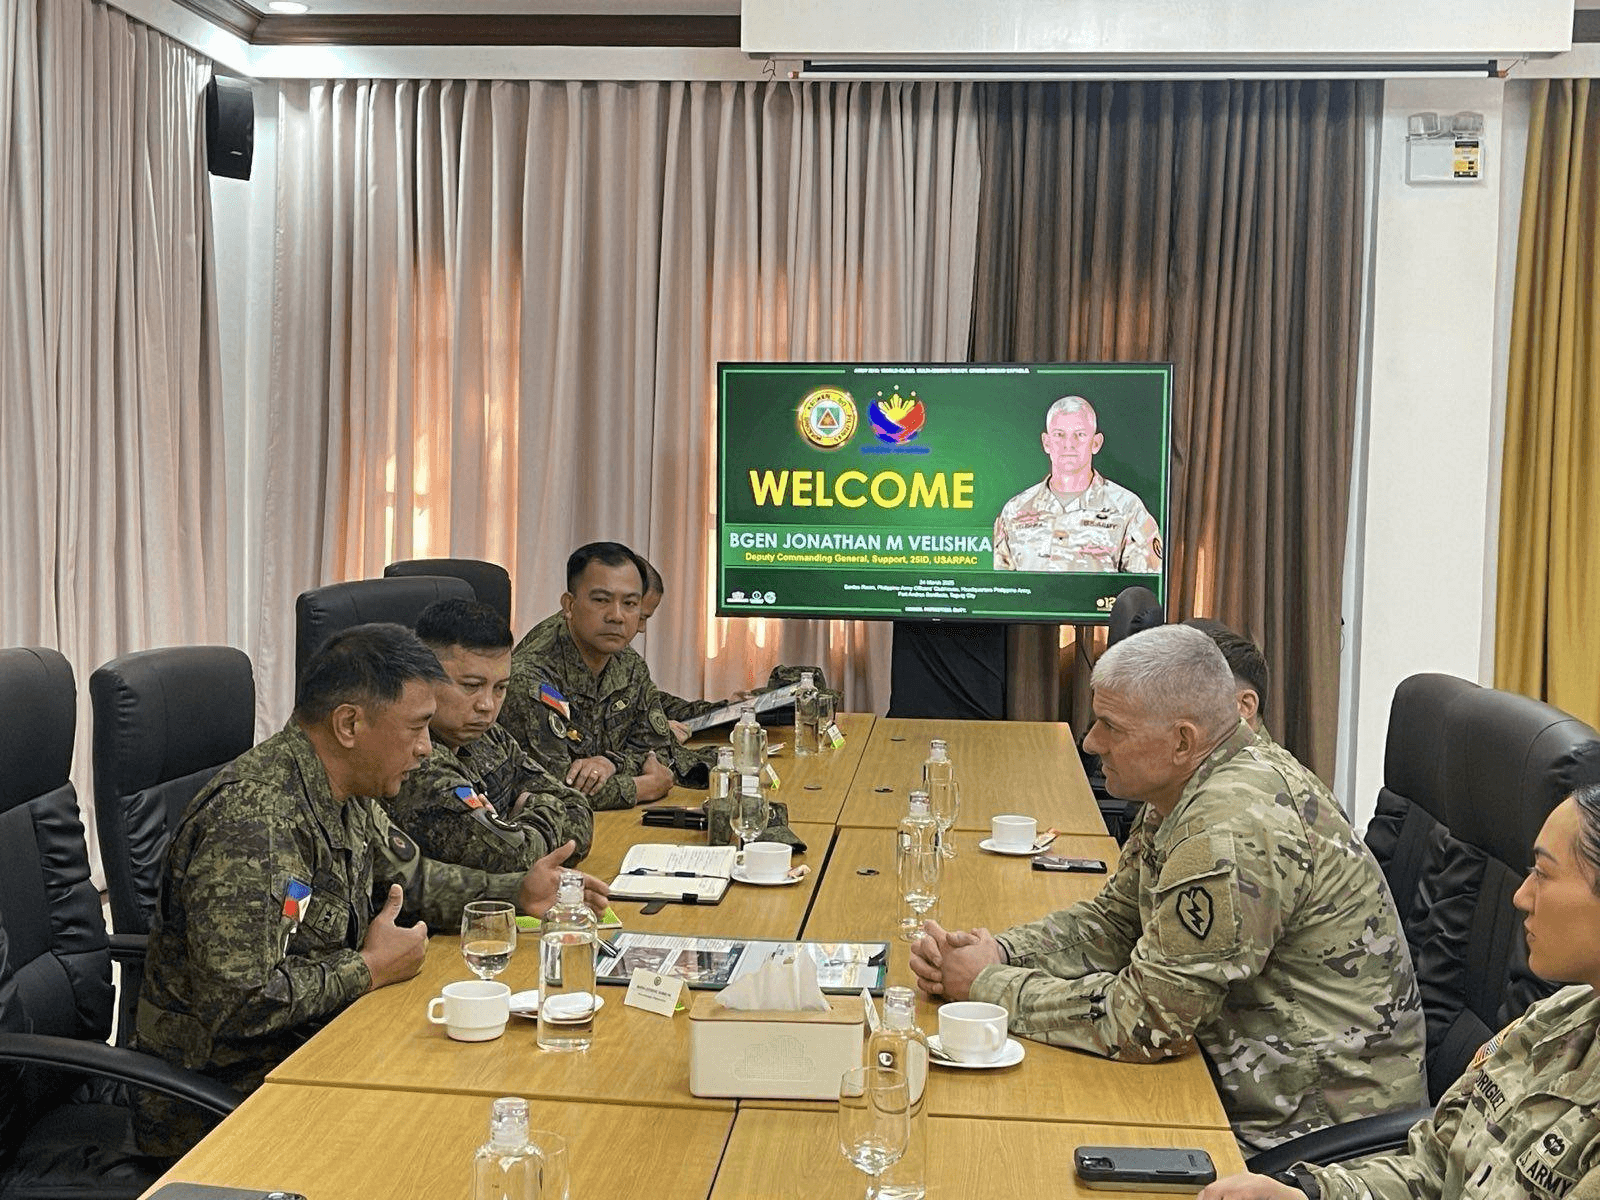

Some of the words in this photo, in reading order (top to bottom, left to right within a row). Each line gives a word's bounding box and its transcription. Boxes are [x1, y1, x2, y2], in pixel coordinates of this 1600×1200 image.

[749, 470, 974, 509] WELCOME
[729, 533, 778, 549] BGEN
[782, 533, 881, 550] JONATHAN
[886, 535, 903, 551] M
[908, 535, 993, 552] VELISHKA
[745, 552, 775, 563] Deputy
[777, 553, 833, 564] Commanding
[933, 555, 978, 565] USARPAC
[1526, 1160, 1573, 1199] ARMY
